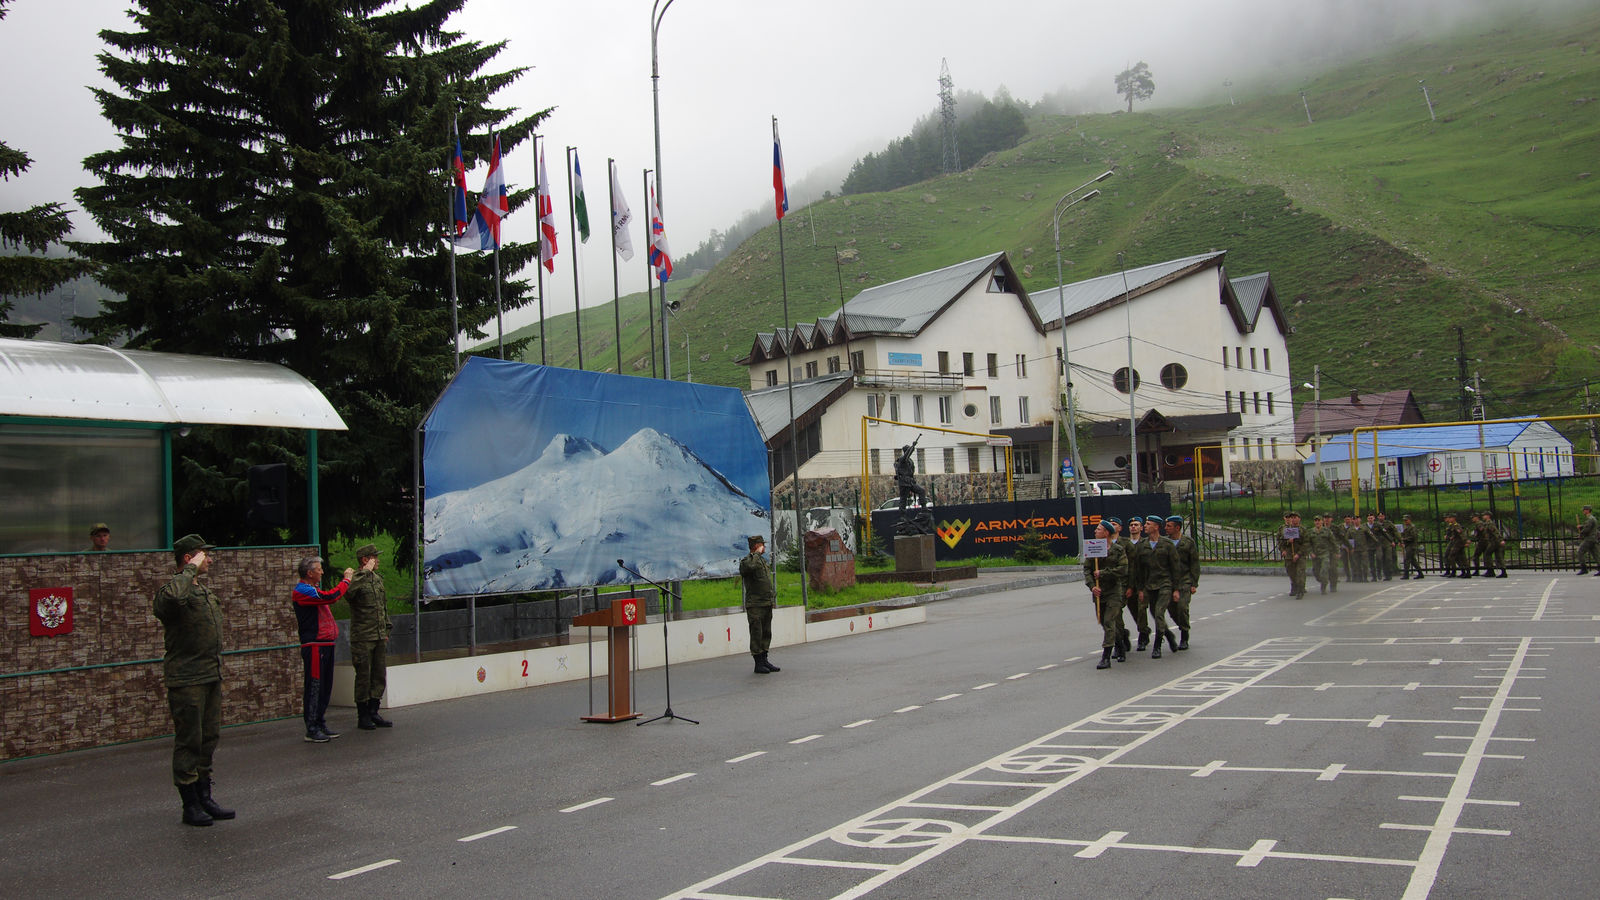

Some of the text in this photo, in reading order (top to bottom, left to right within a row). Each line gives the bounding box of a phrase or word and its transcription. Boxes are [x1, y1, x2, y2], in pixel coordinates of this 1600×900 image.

[975, 514, 1102, 531] ARMYGAMES
[974, 533, 1068, 544] INTERNANAL
[868, 616, 873, 629] 3
[726, 627, 731, 642] 1
[521, 659, 529, 677] 2
